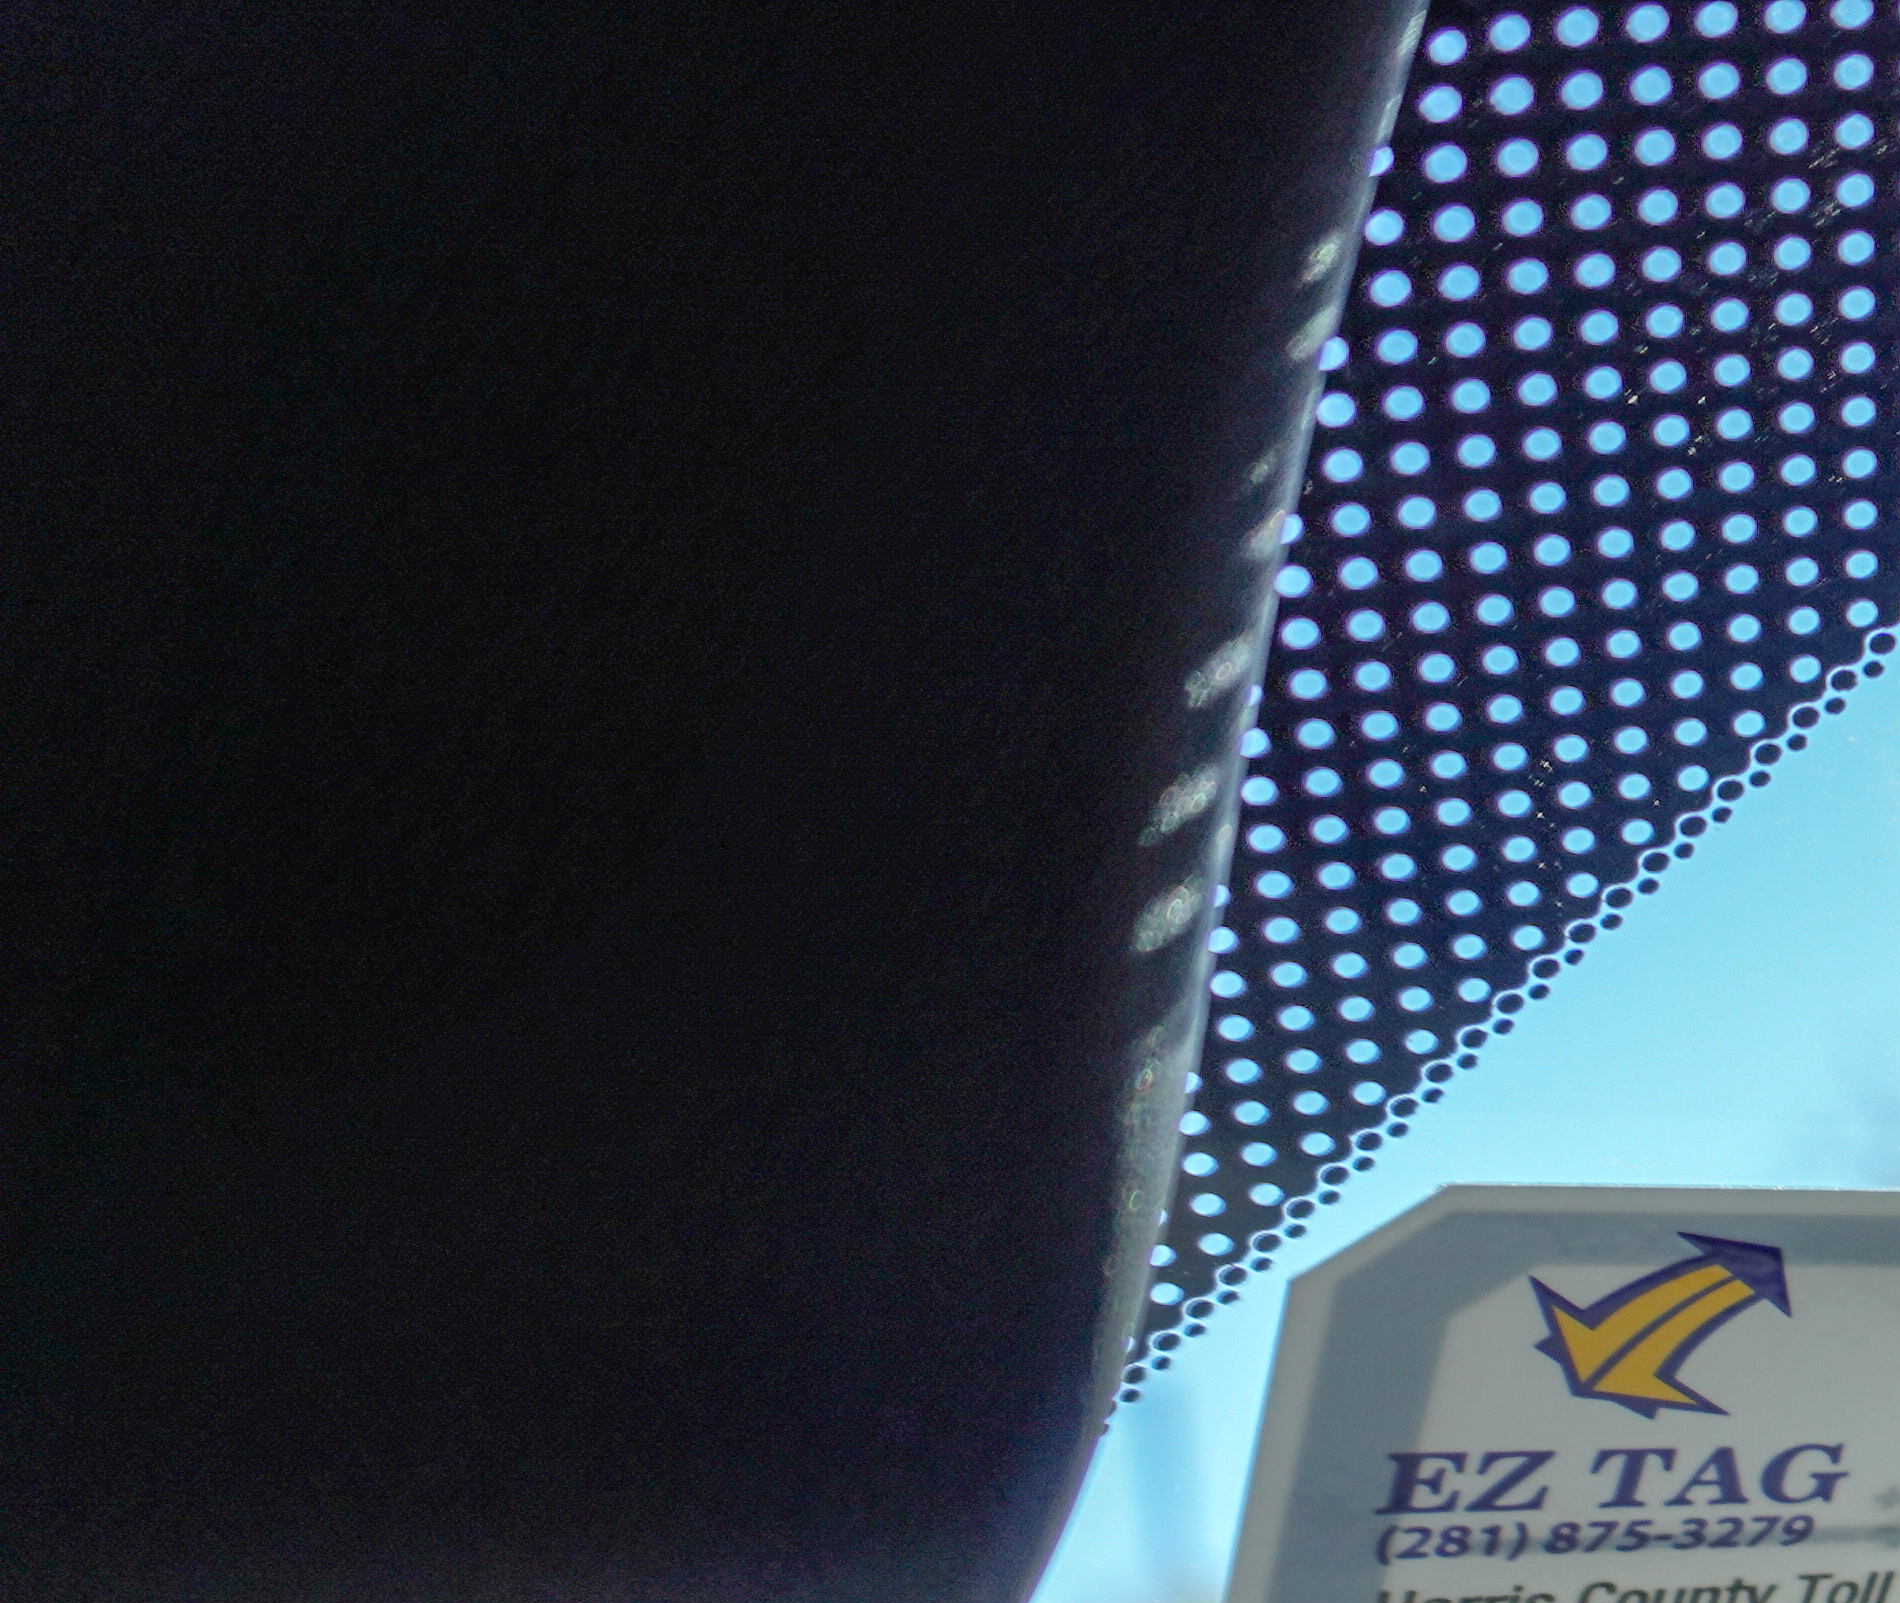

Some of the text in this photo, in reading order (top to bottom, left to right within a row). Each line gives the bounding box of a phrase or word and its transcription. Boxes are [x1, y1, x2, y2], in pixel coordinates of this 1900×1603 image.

[1375, 1443, 1850, 1515] EZ TAG
[1376, 1514, 1816, 1566] (281) 875-3279
